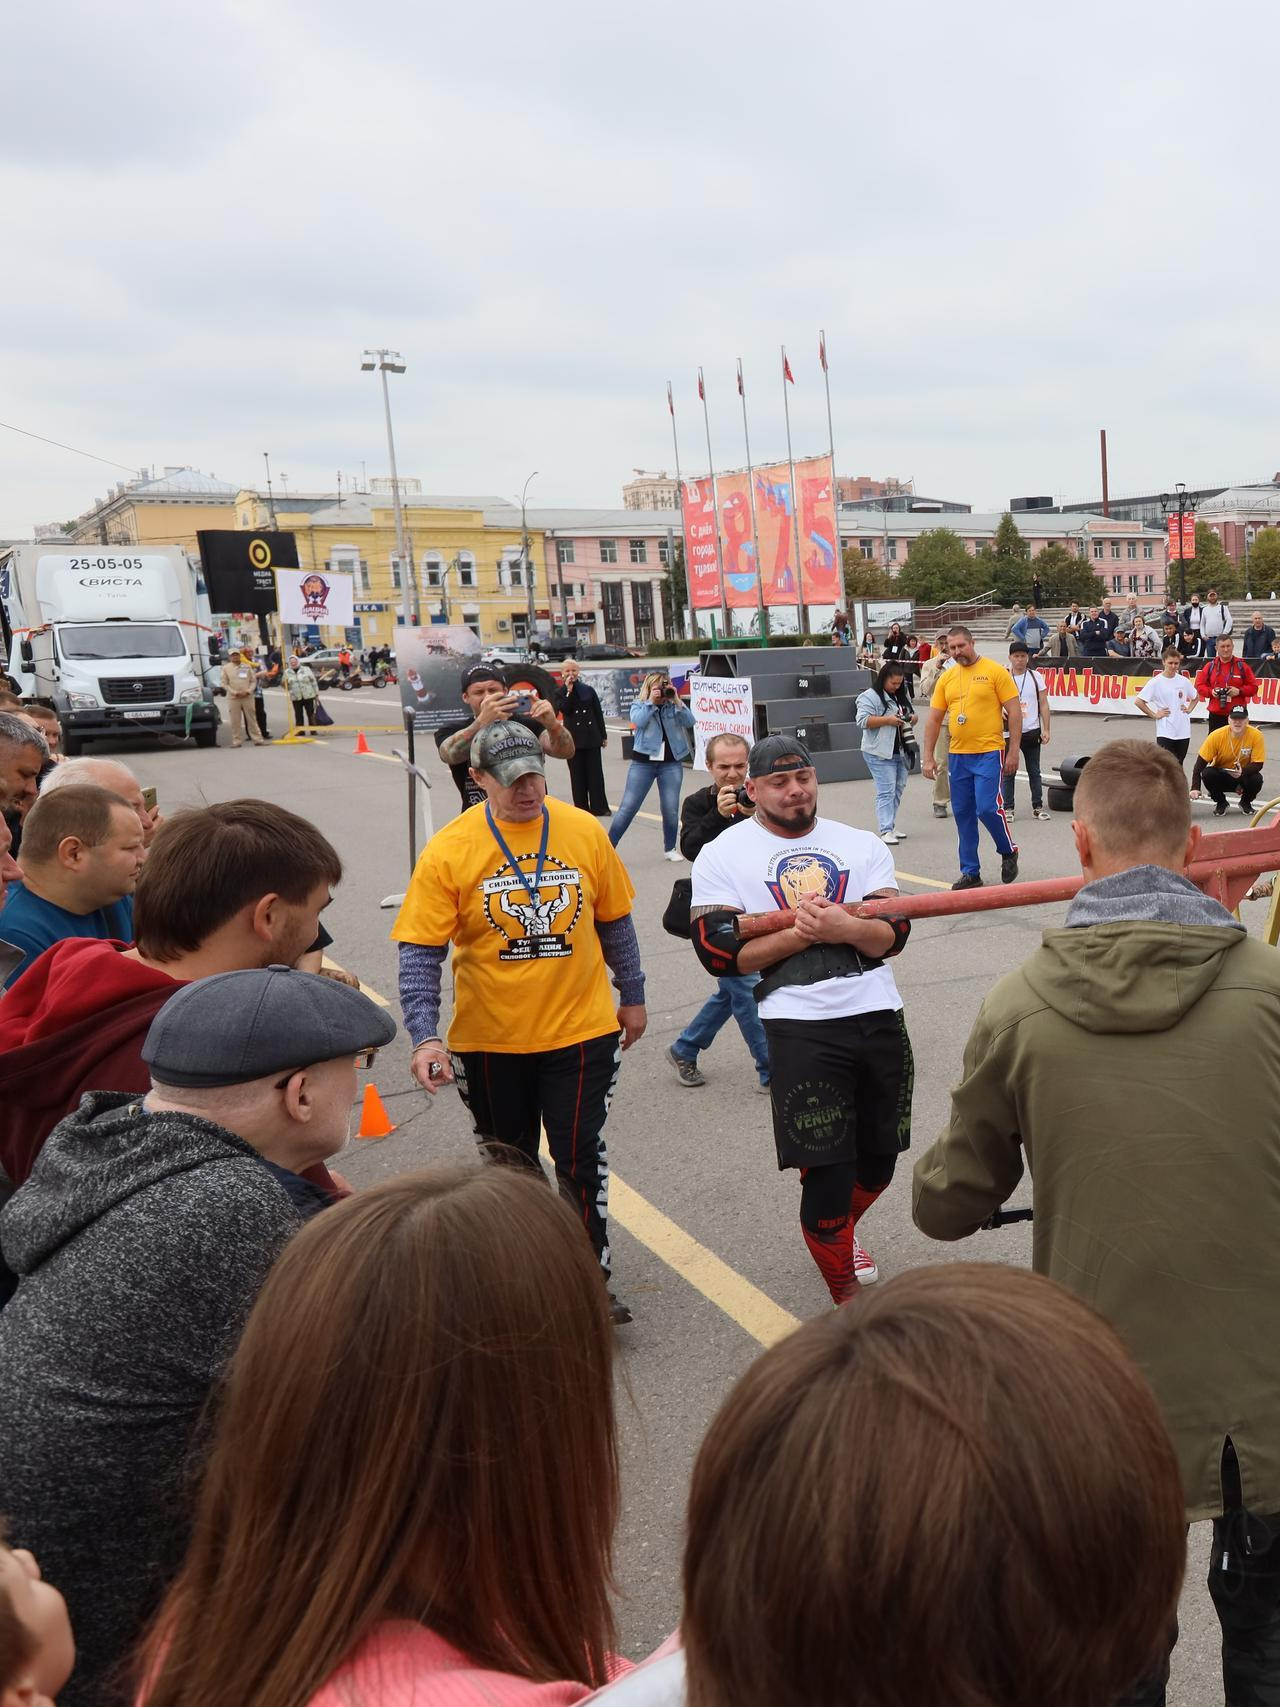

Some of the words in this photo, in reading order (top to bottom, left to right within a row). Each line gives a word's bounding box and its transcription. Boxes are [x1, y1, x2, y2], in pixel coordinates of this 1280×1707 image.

[70, 558, 143, 570] 25-05-05
[88, 578, 143, 586] ВИСТА
[692, 681, 749, 695] ФИТНЕС-ЦЕНТР
[798, 679, 809, 688] 200
[1036, 667, 1079, 697] ИЛА
[1083, 667, 1128, 705] Тулы
[696, 697, 749, 715] «САЛЮТ»
[729, 724, 751, 735] СКИДКИ
[796, 728, 807, 738] 240
[488, 875, 533, 889] СИЛЬНЙ
[512, 943, 562, 954] ФЕДАЦИЯ
[795, 1107, 843, 1131] VENUM
